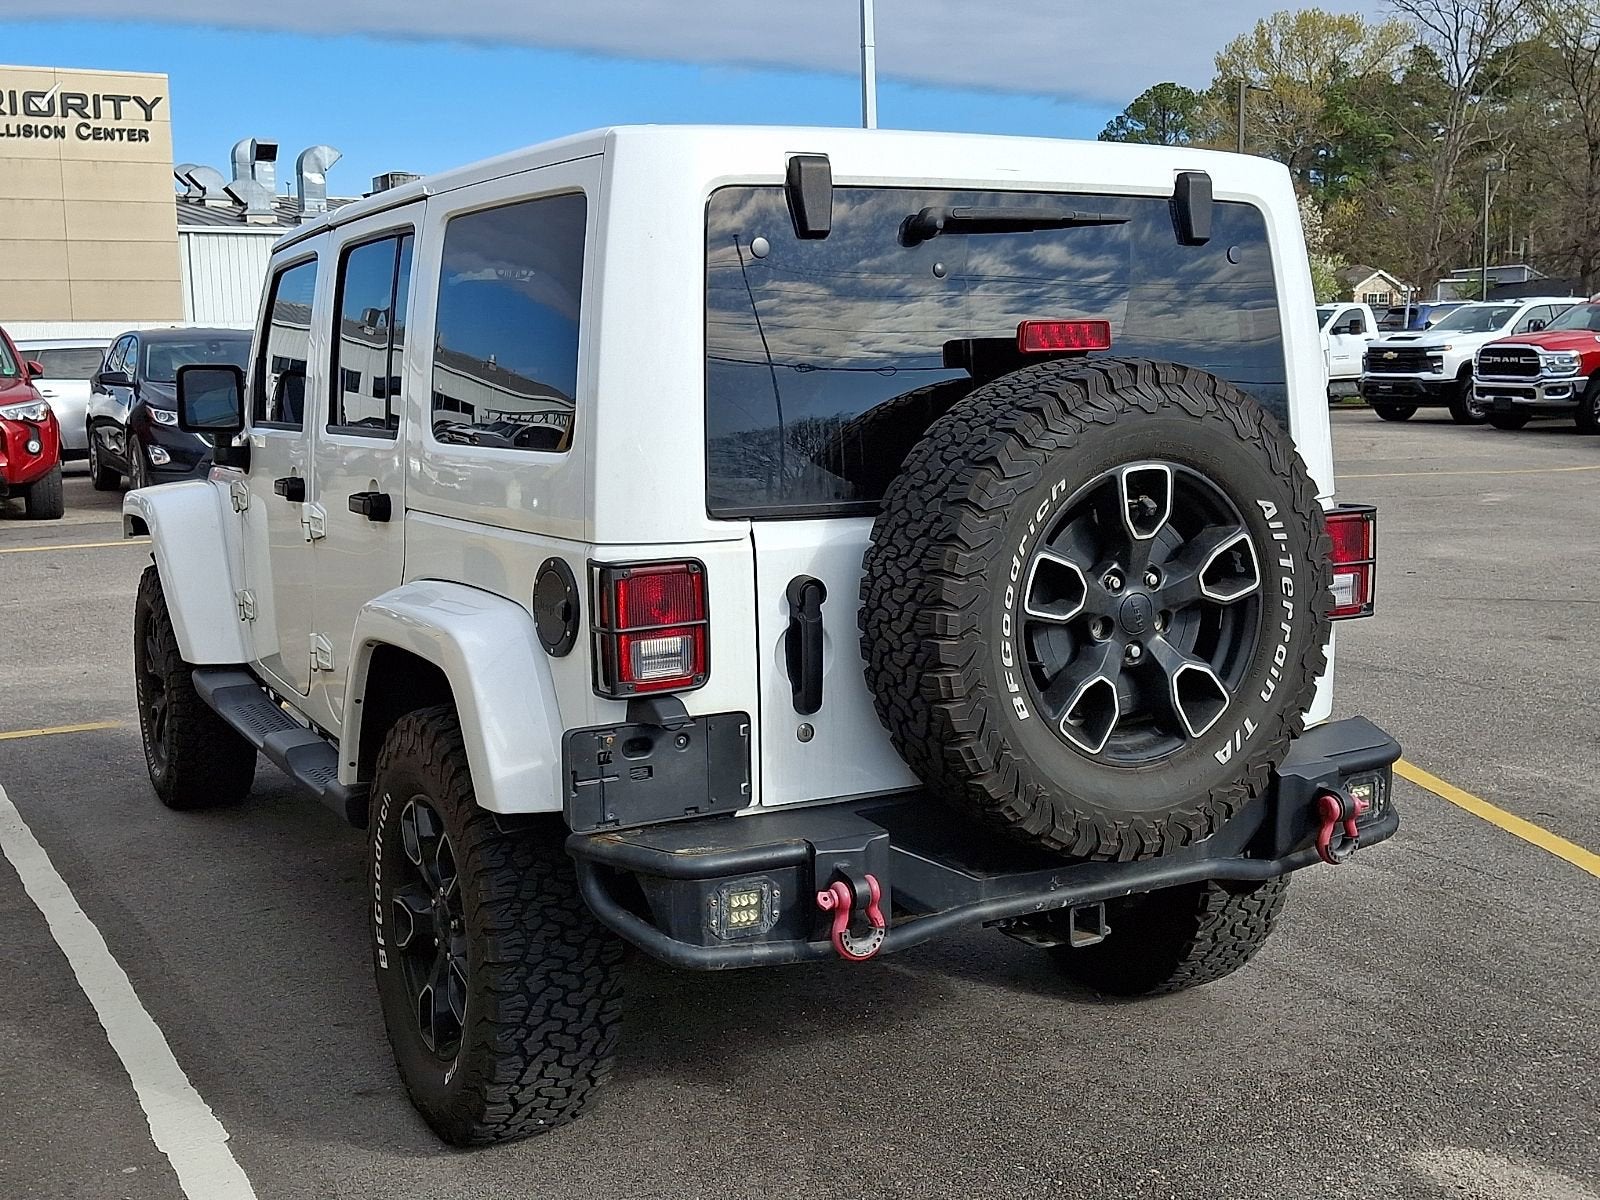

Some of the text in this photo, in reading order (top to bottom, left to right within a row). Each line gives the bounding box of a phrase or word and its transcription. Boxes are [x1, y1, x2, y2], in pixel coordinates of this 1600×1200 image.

[0, 89, 163, 122] IORITY
[1001, 478, 1066, 720] BFGoodrich
[1214, 499, 1296, 765] All-Terrain T/A
[374, 792, 392, 970] BFGoodrich
